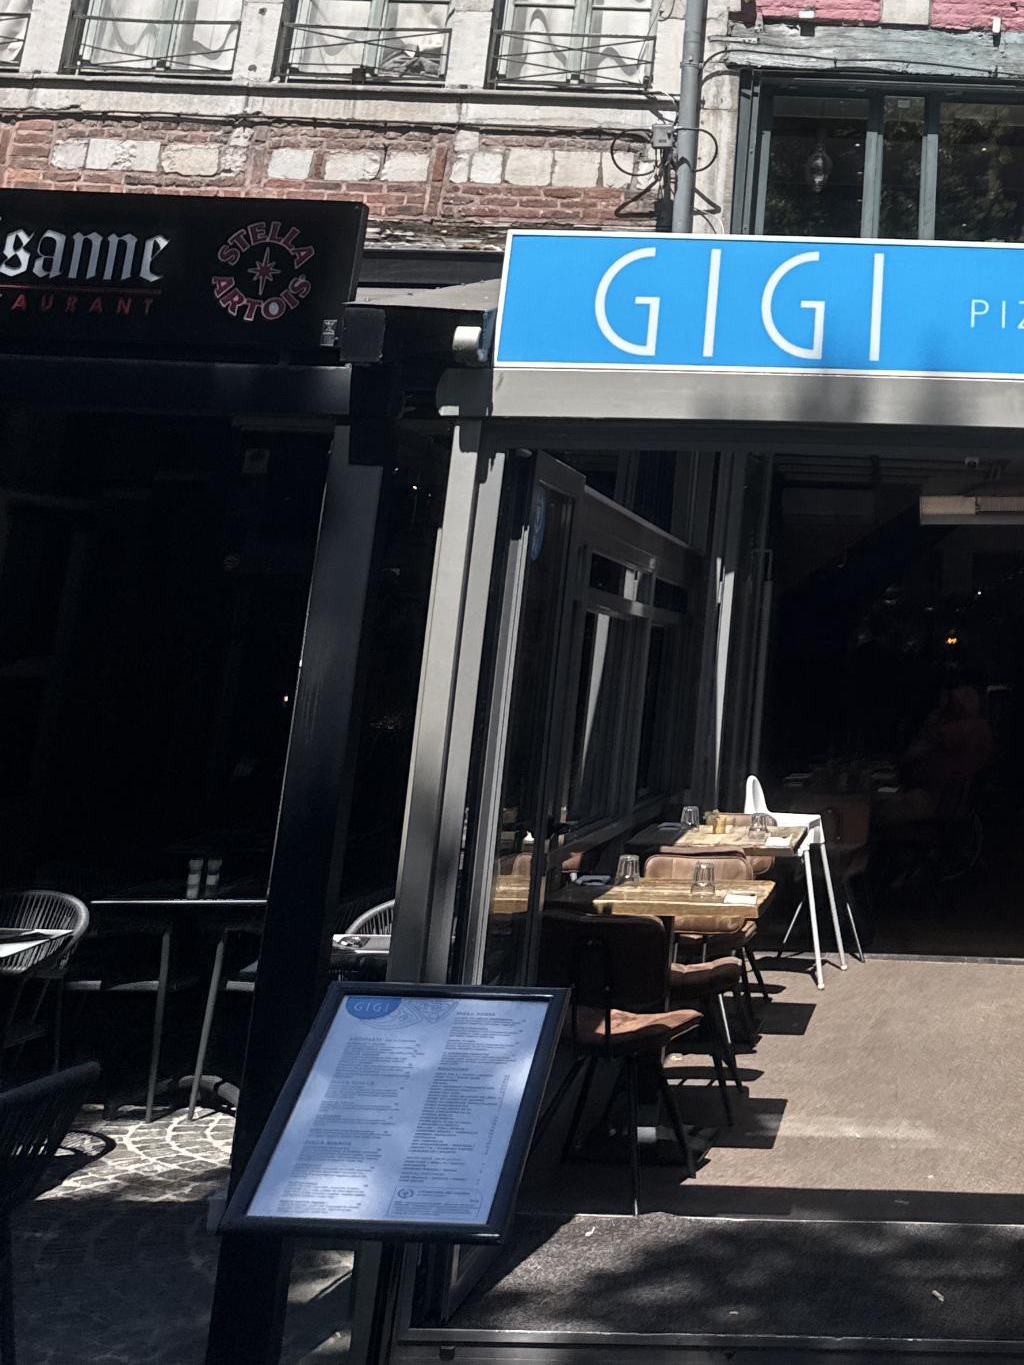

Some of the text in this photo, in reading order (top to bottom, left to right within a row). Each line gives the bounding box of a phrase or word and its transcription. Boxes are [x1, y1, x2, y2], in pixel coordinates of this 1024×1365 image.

[217, 220, 315, 270] STELLA
[0, 293, 154, 315] AURANT
[211, 275, 312, 322] ARTOIS
[594, 247, 884, 362] GIGI
[353, 1001, 390, 1012] GIGI
